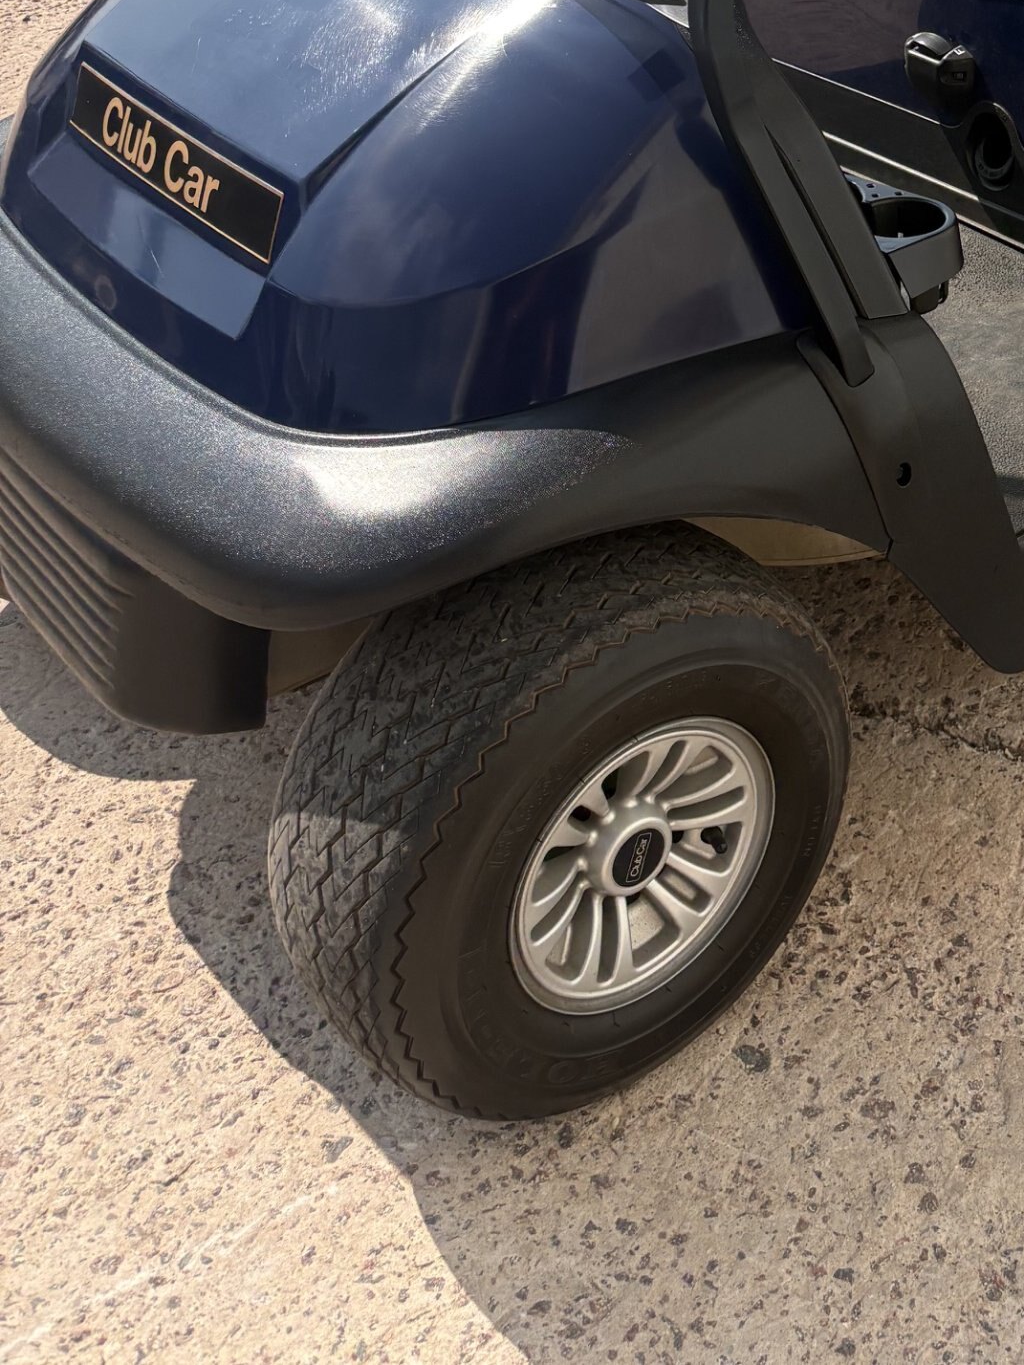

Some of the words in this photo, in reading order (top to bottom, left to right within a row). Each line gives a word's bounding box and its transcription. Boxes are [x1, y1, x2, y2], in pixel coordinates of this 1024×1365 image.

[102, 96, 157, 174] Club
[163, 139, 220, 214] Car
[635, 837, 648, 855] Car
[630, 854, 643, 878] Club
